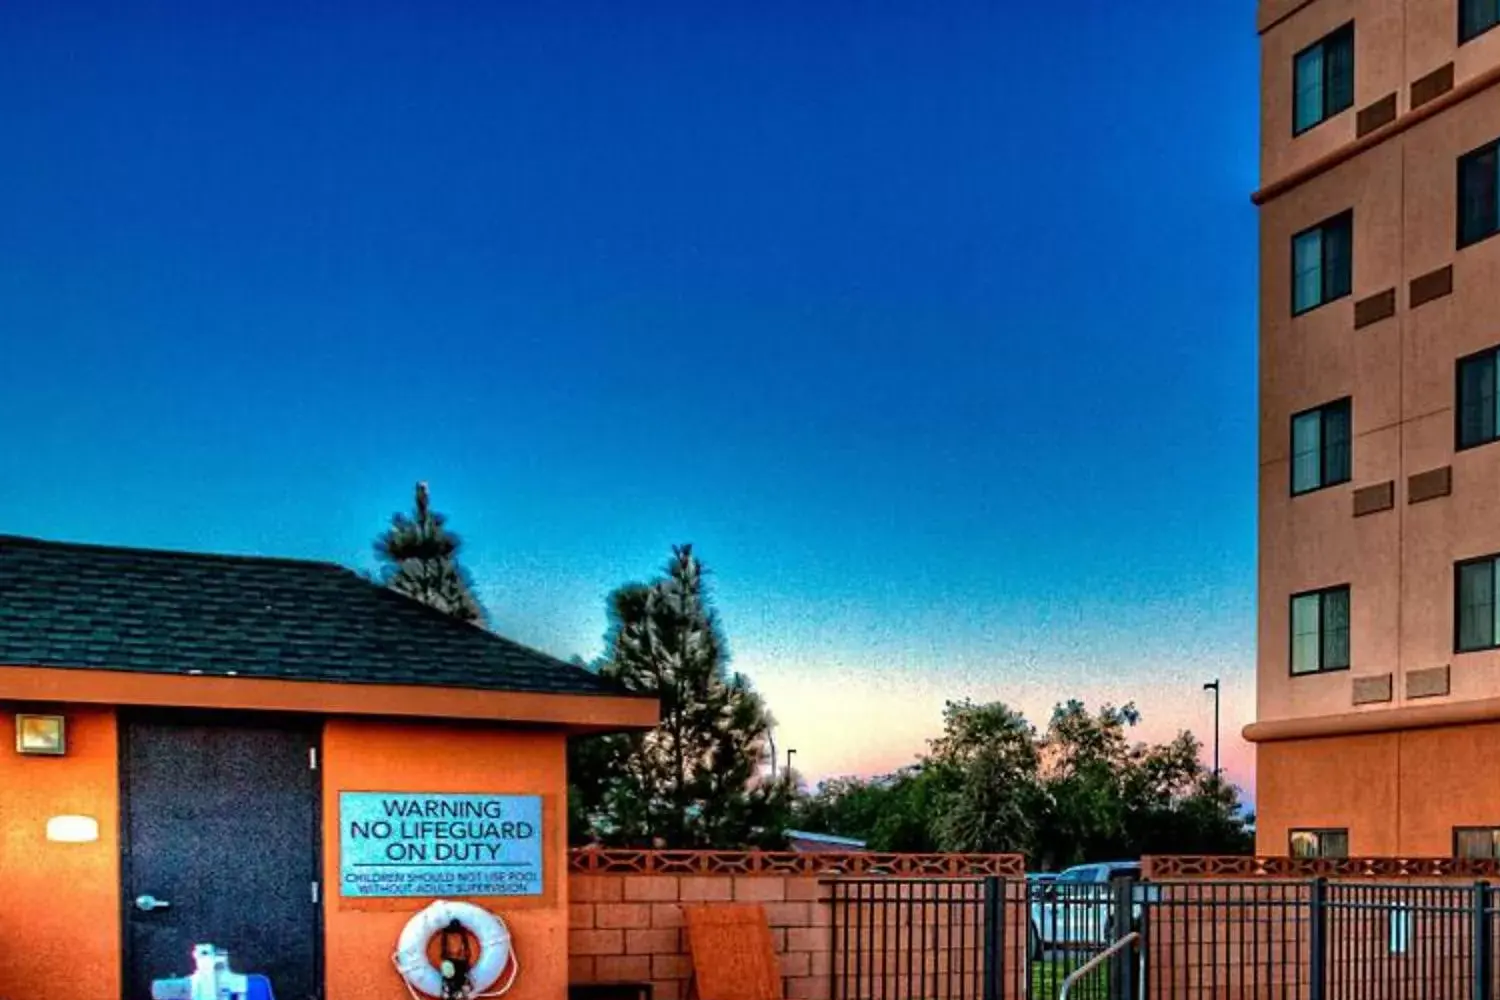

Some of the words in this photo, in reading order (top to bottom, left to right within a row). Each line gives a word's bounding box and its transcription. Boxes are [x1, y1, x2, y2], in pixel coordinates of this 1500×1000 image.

[383, 799, 501, 819] WARNING
[351, 821, 392, 839] NO
[401, 821, 533, 840] LIFEGUARD
[386, 843, 427, 861] ON
[435, 843, 502, 861] DUTY
[407, 872, 455, 883] SHOULD
[457, 872, 482, 882] NOT
